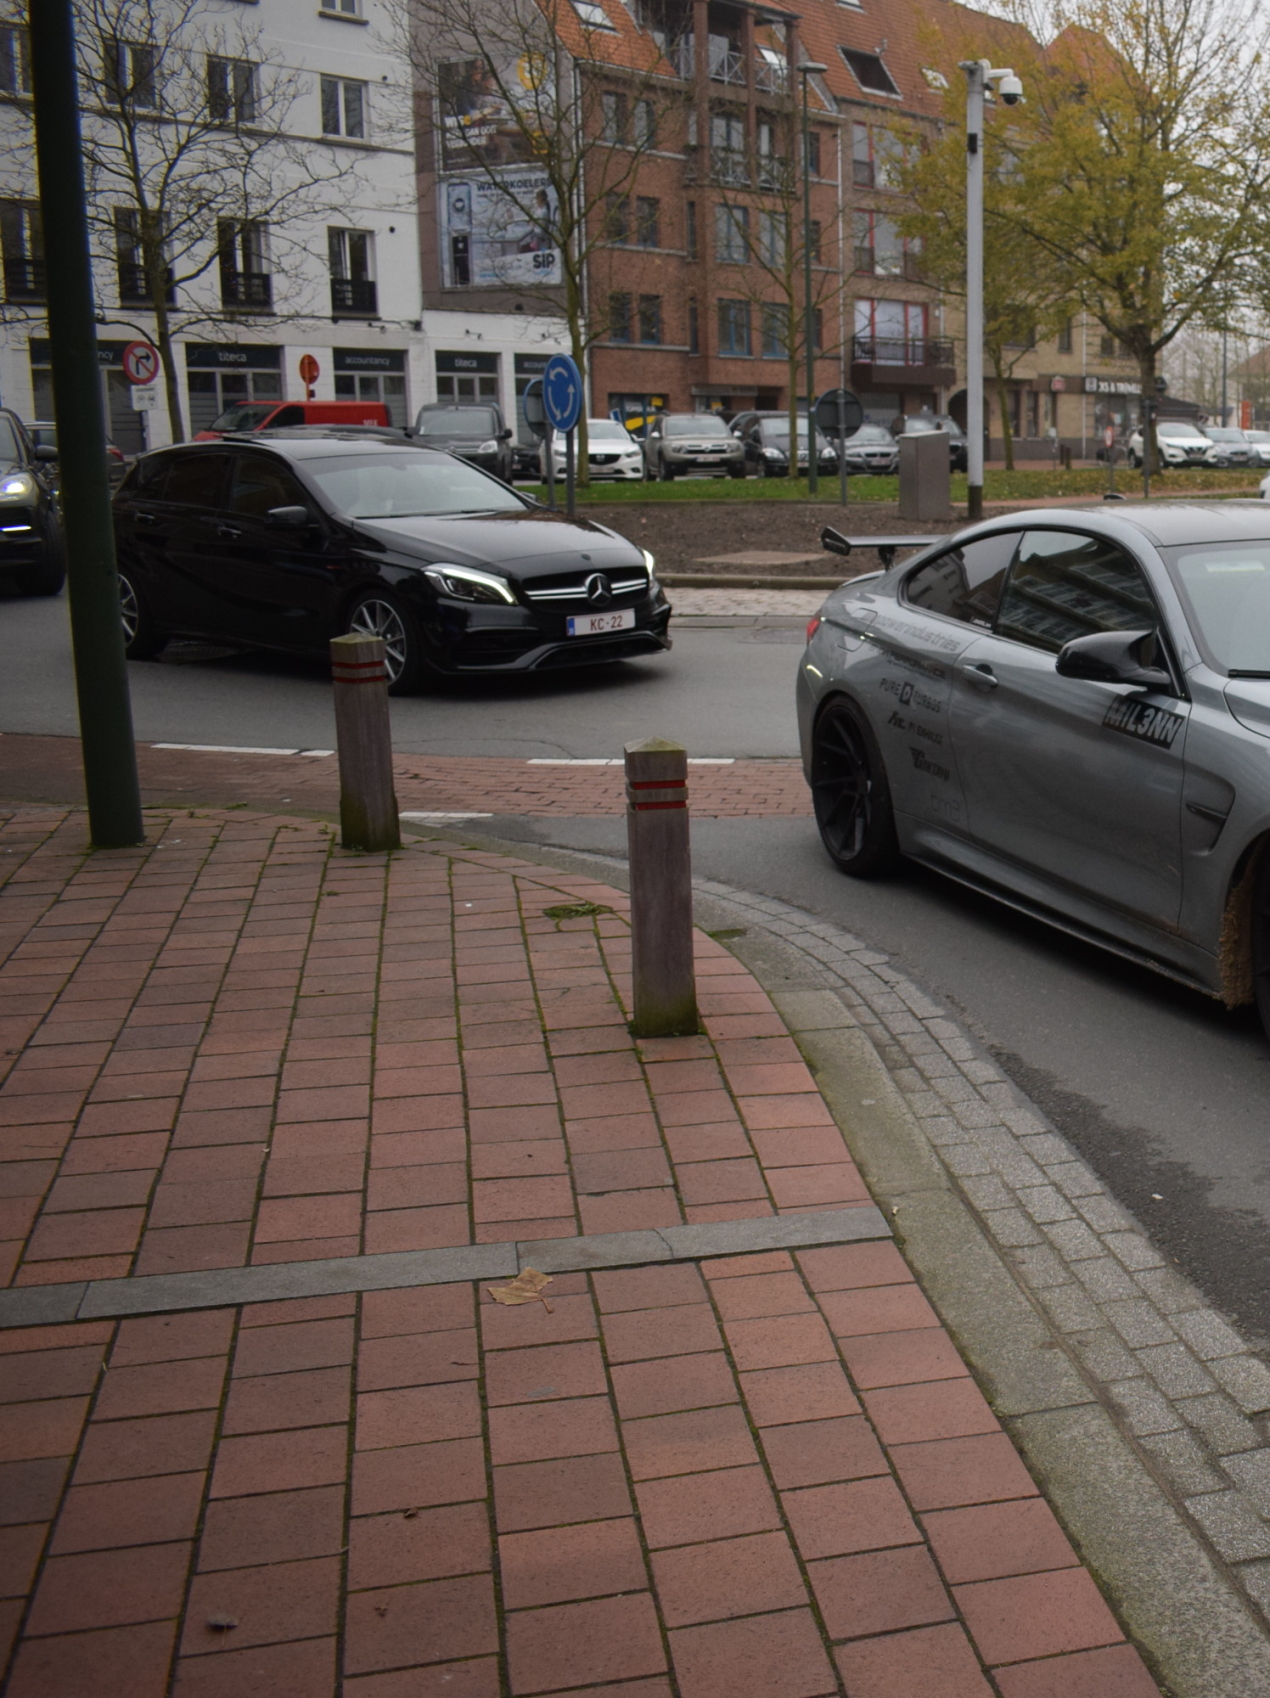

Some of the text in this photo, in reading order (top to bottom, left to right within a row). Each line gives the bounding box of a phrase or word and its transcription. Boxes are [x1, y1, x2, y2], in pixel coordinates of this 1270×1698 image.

[219, 350, 247, 363] titeca
[344, 355, 390, 367] accountancy
[455, 357, 477, 368] titeca
[879, 677, 942, 713] PURE TURBOS
[1104, 698, 1182, 744] MIL3NN
